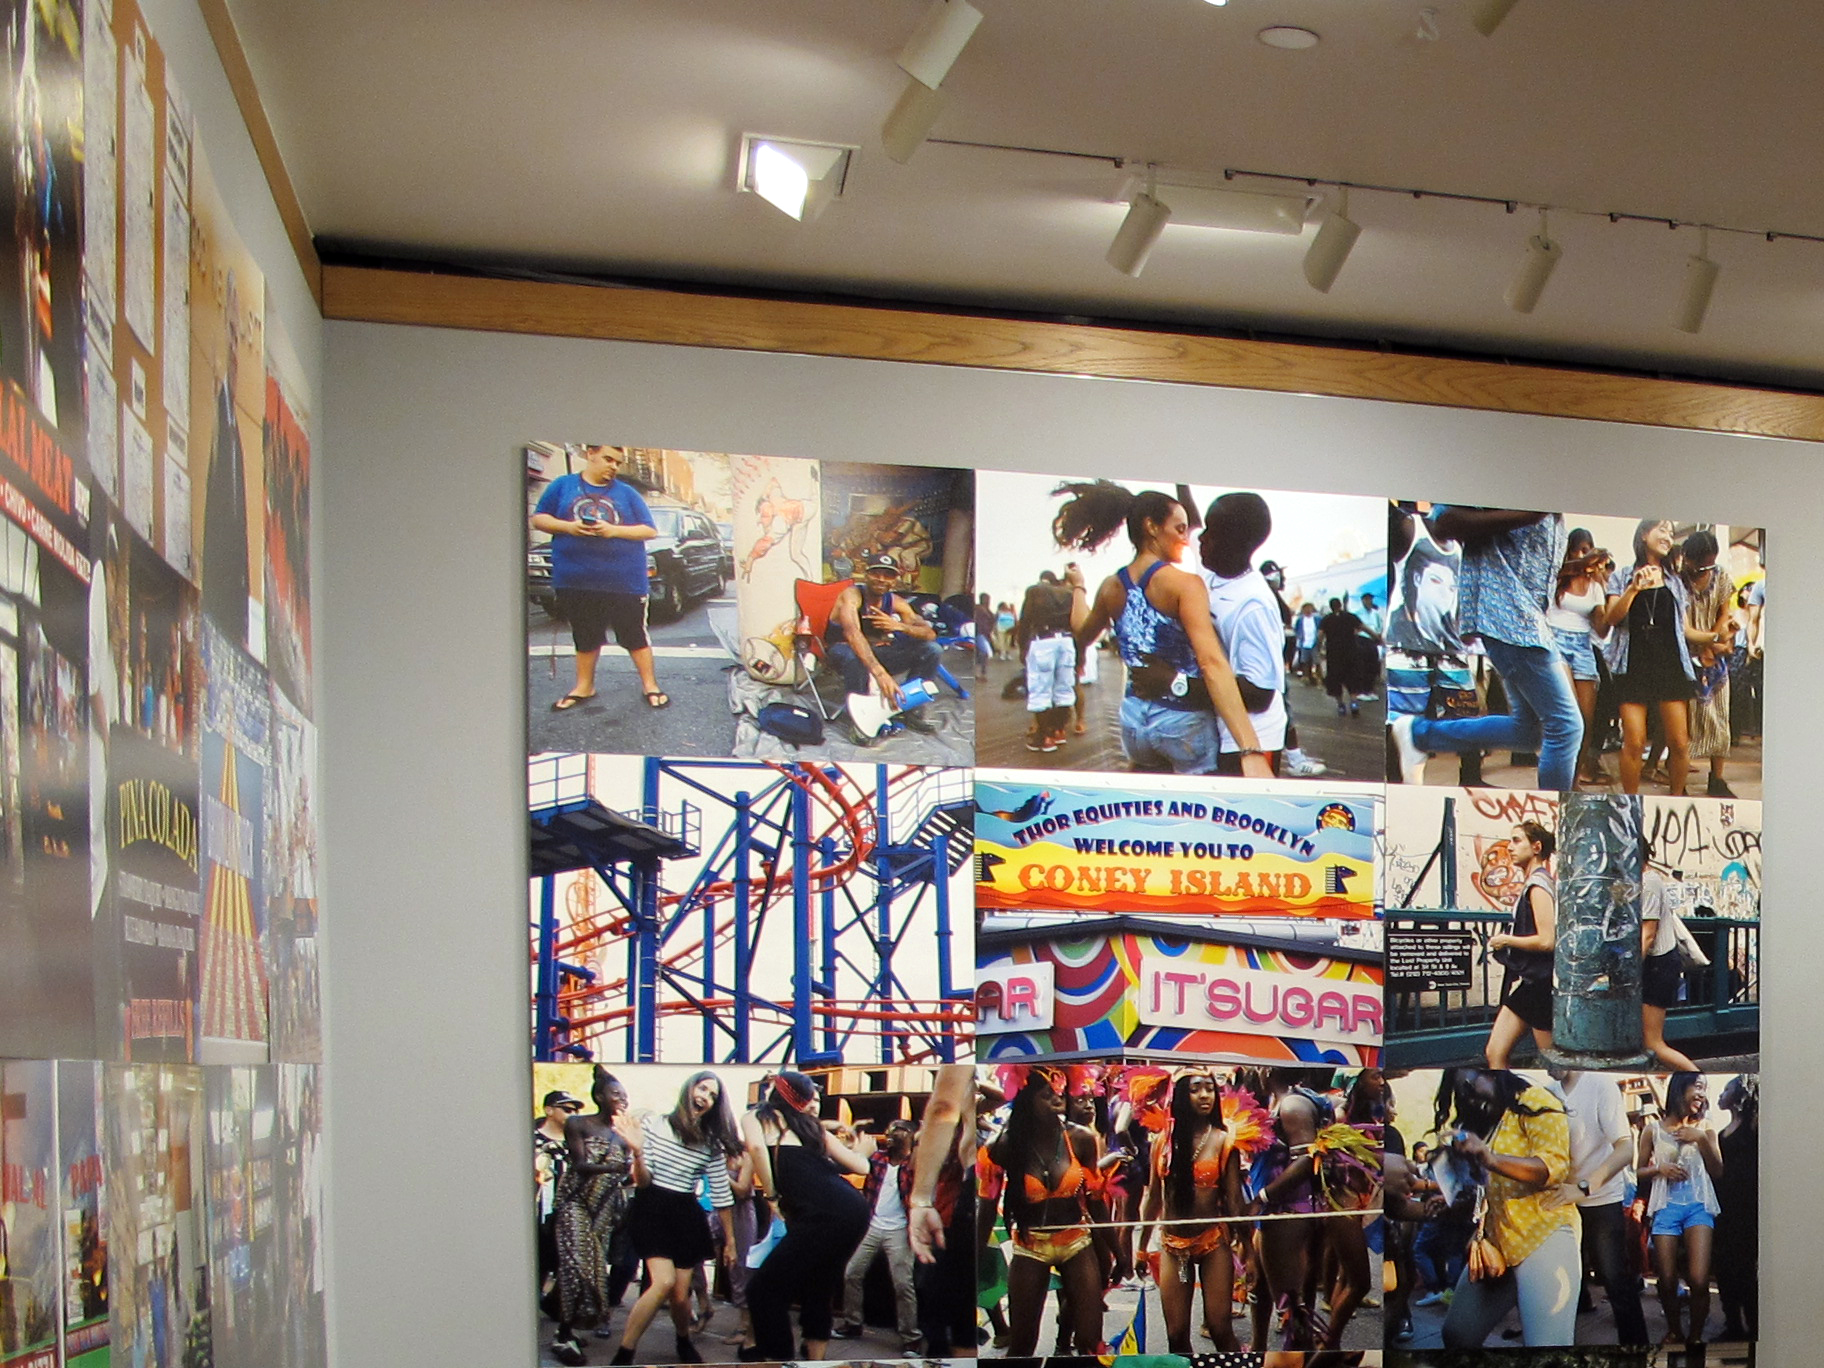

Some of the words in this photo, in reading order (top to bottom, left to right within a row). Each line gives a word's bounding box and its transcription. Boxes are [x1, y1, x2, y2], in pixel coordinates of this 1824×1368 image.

[31, 419, 73, 515] MEAT
[119, 778, 148, 848] PINA
[149, 780, 198, 875] COLADA
[1012, 813, 1071, 846] THOR
[1073, 800, 1163, 827] EQUITIES
[1168, 800, 1208, 820] AND
[1212, 804, 1316, 857] BROOKLYN
[1074, 837, 1175, 858] WELCOME
[1179, 842, 1223, 861] YOU
[1227, 844, 1255, 861] TO
[1018, 863, 1152, 894] CONEY
[1170, 868, 1313, 899] ISLAND
[1149, 970, 1384, 1036] IT'SUGAR
